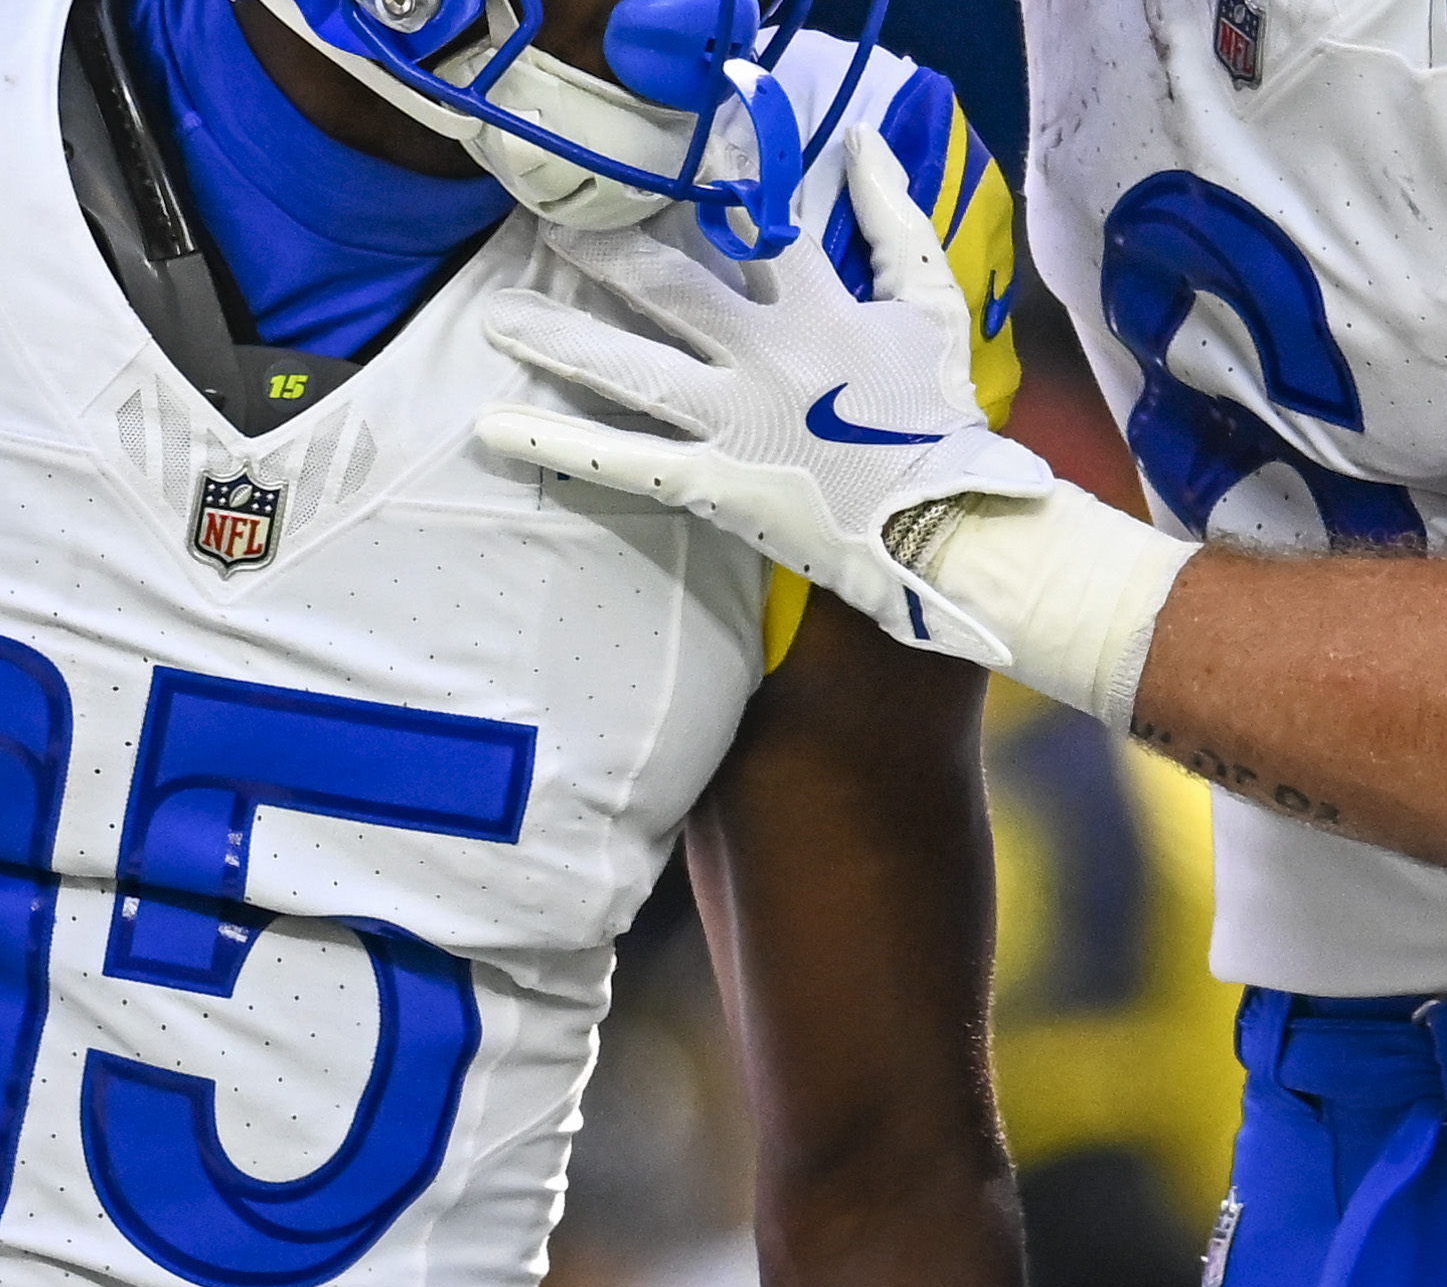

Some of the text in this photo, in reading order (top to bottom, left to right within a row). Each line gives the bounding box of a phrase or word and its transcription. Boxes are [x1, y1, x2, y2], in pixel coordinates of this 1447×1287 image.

[1219, 21, 1253, 74] NFL
[269, 374, 309, 399] 15
[1101, 169, 1428, 555] 6
[202, 512, 263, 558] NFL
